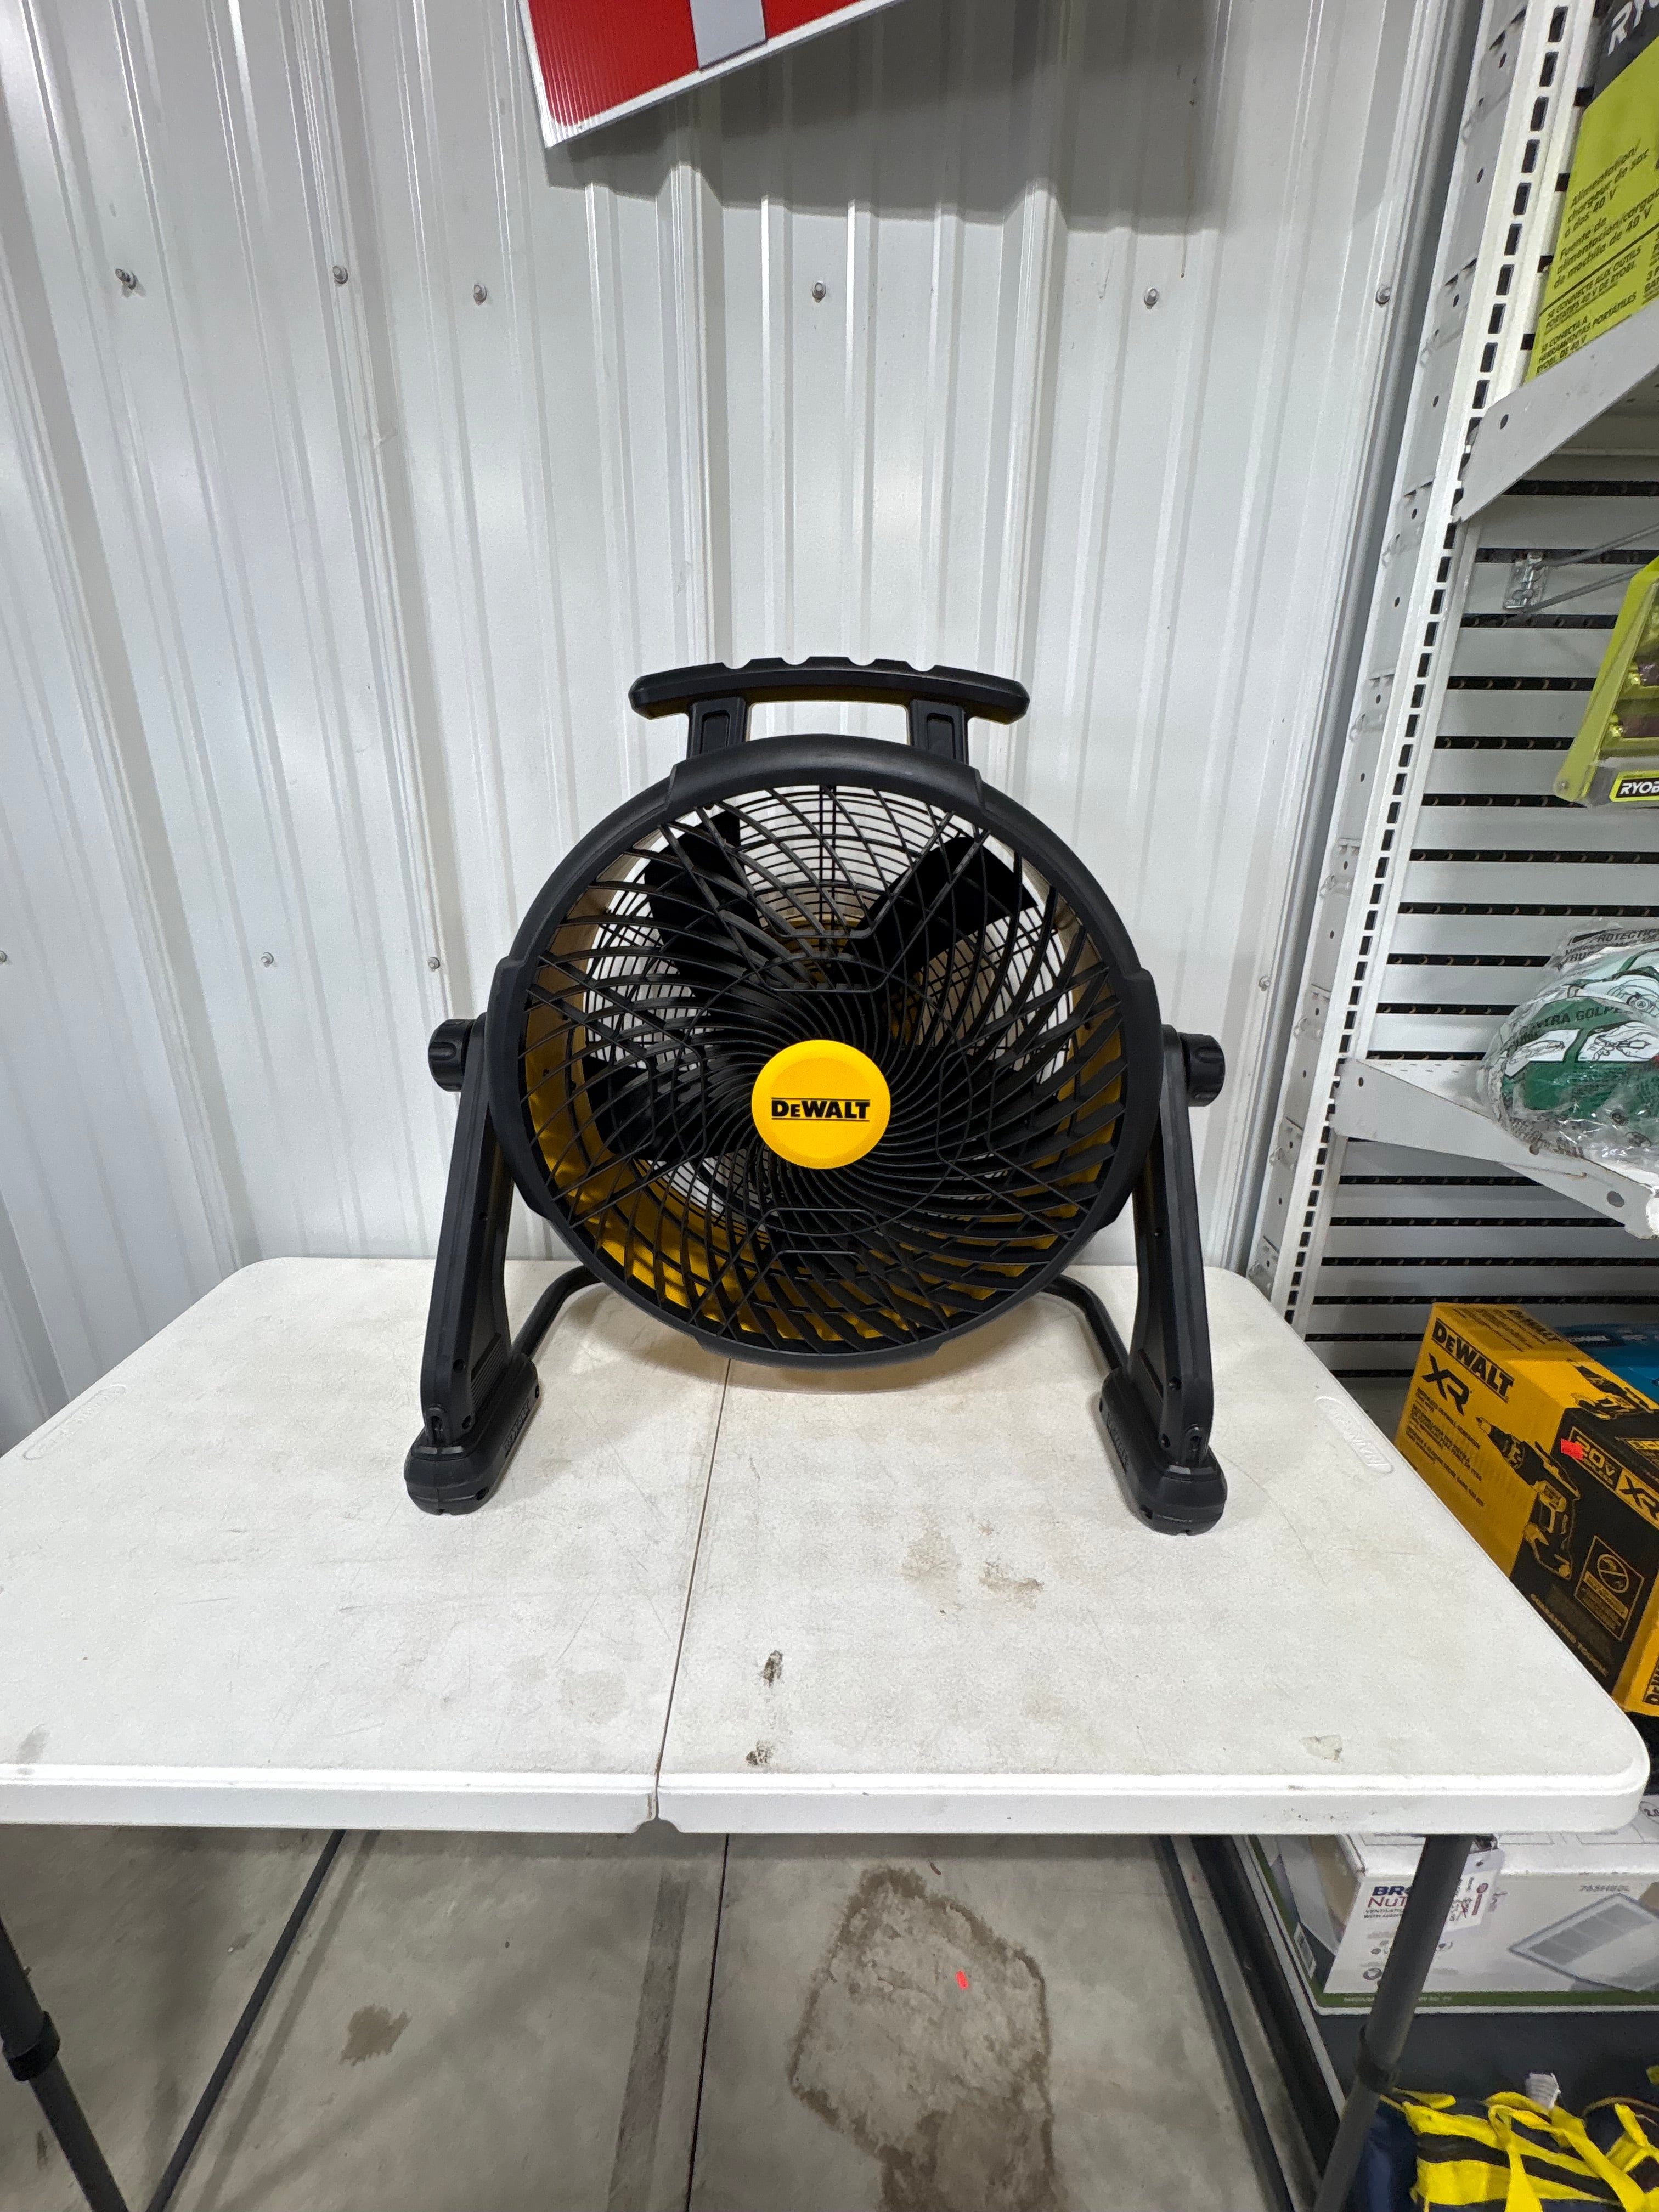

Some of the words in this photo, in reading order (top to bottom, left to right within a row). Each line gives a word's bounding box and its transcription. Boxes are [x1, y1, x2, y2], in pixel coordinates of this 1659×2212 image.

[1615, 168, 1628, 184] de
[1630, 149, 1649, 171] sac
[1593, 196, 1605, 213] 40
[1594, 218, 1607, 233] de
[1610, 232, 1622, 246] de
[1626, 215, 1640, 233] 40
[1645, 204, 1652, 219] V
[771, 1099, 871, 1119] DEWALT
[1432, 1318, 1514, 1398] DEWALT
[1421, 1353, 1469, 1415] XR
